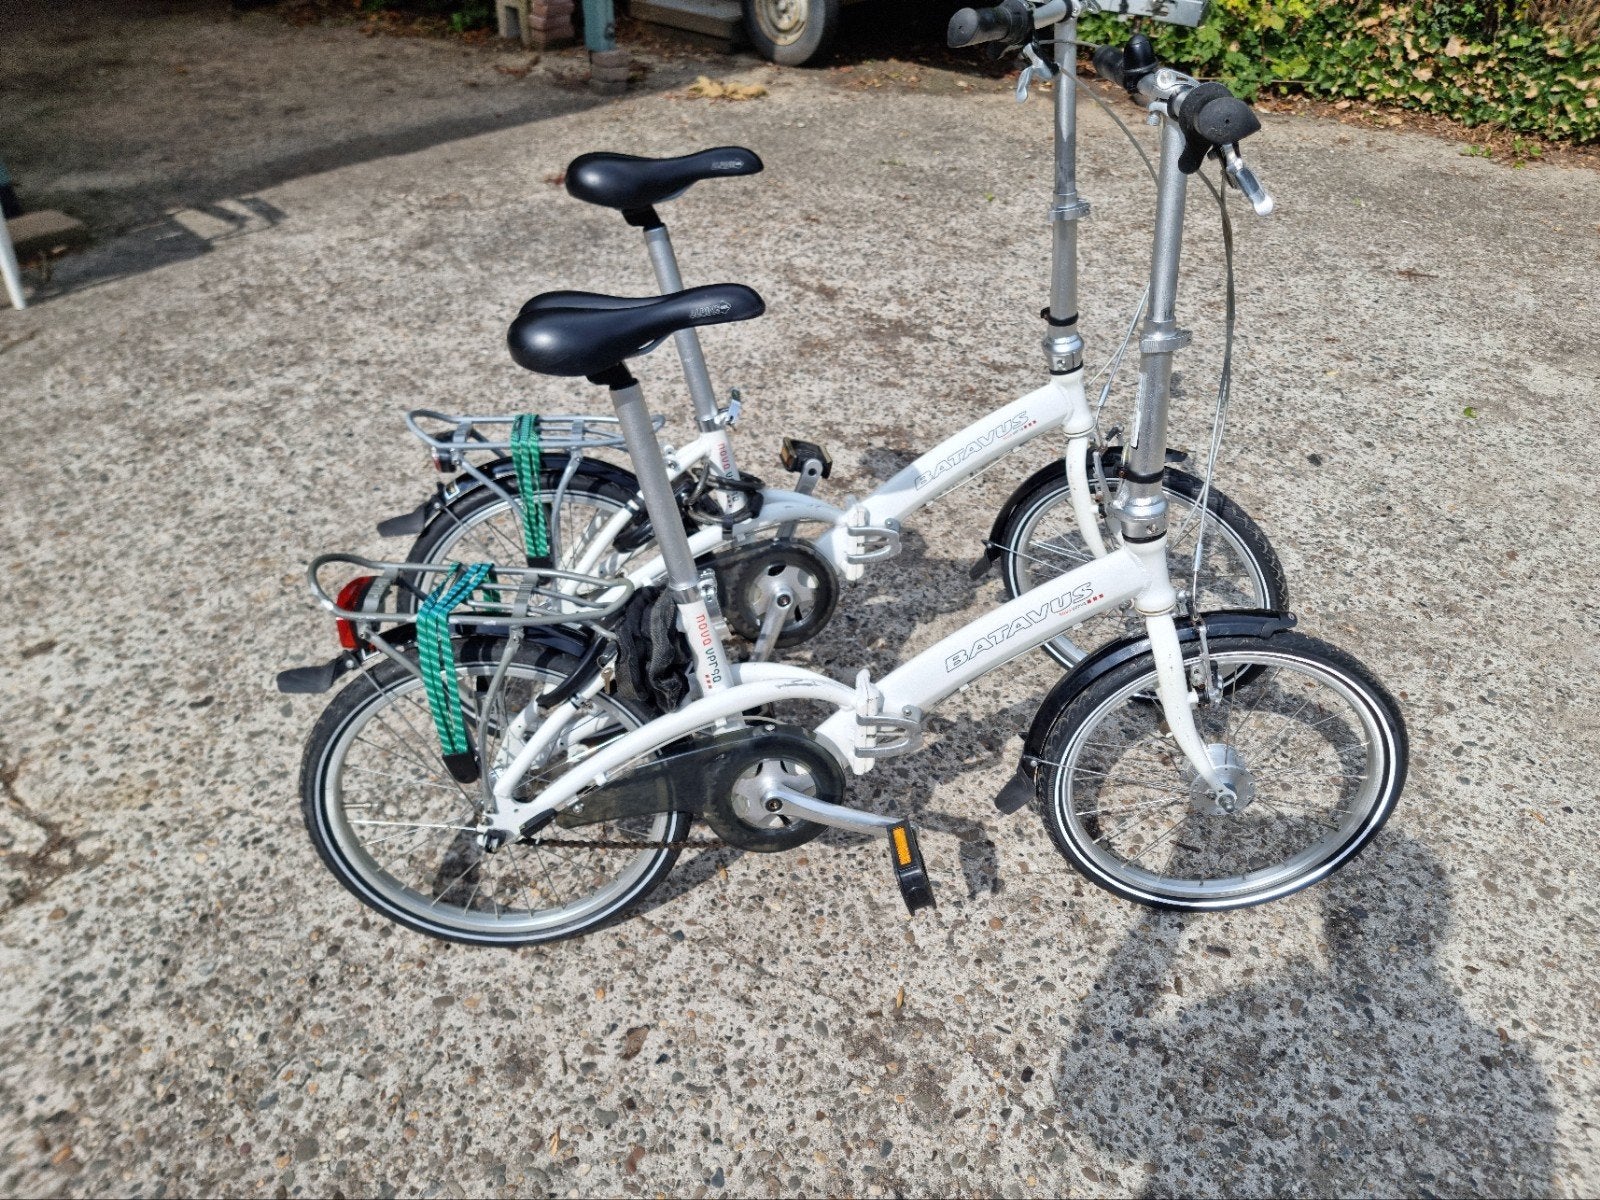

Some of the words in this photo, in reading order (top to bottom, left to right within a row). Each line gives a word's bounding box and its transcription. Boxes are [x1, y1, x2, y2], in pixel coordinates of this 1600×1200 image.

[718, 442, 731, 470] nova
[914, 410, 1029, 491] BATAVUS
[696, 614, 713, 647] nova
[945, 581, 1094, 673] BATAVUS
